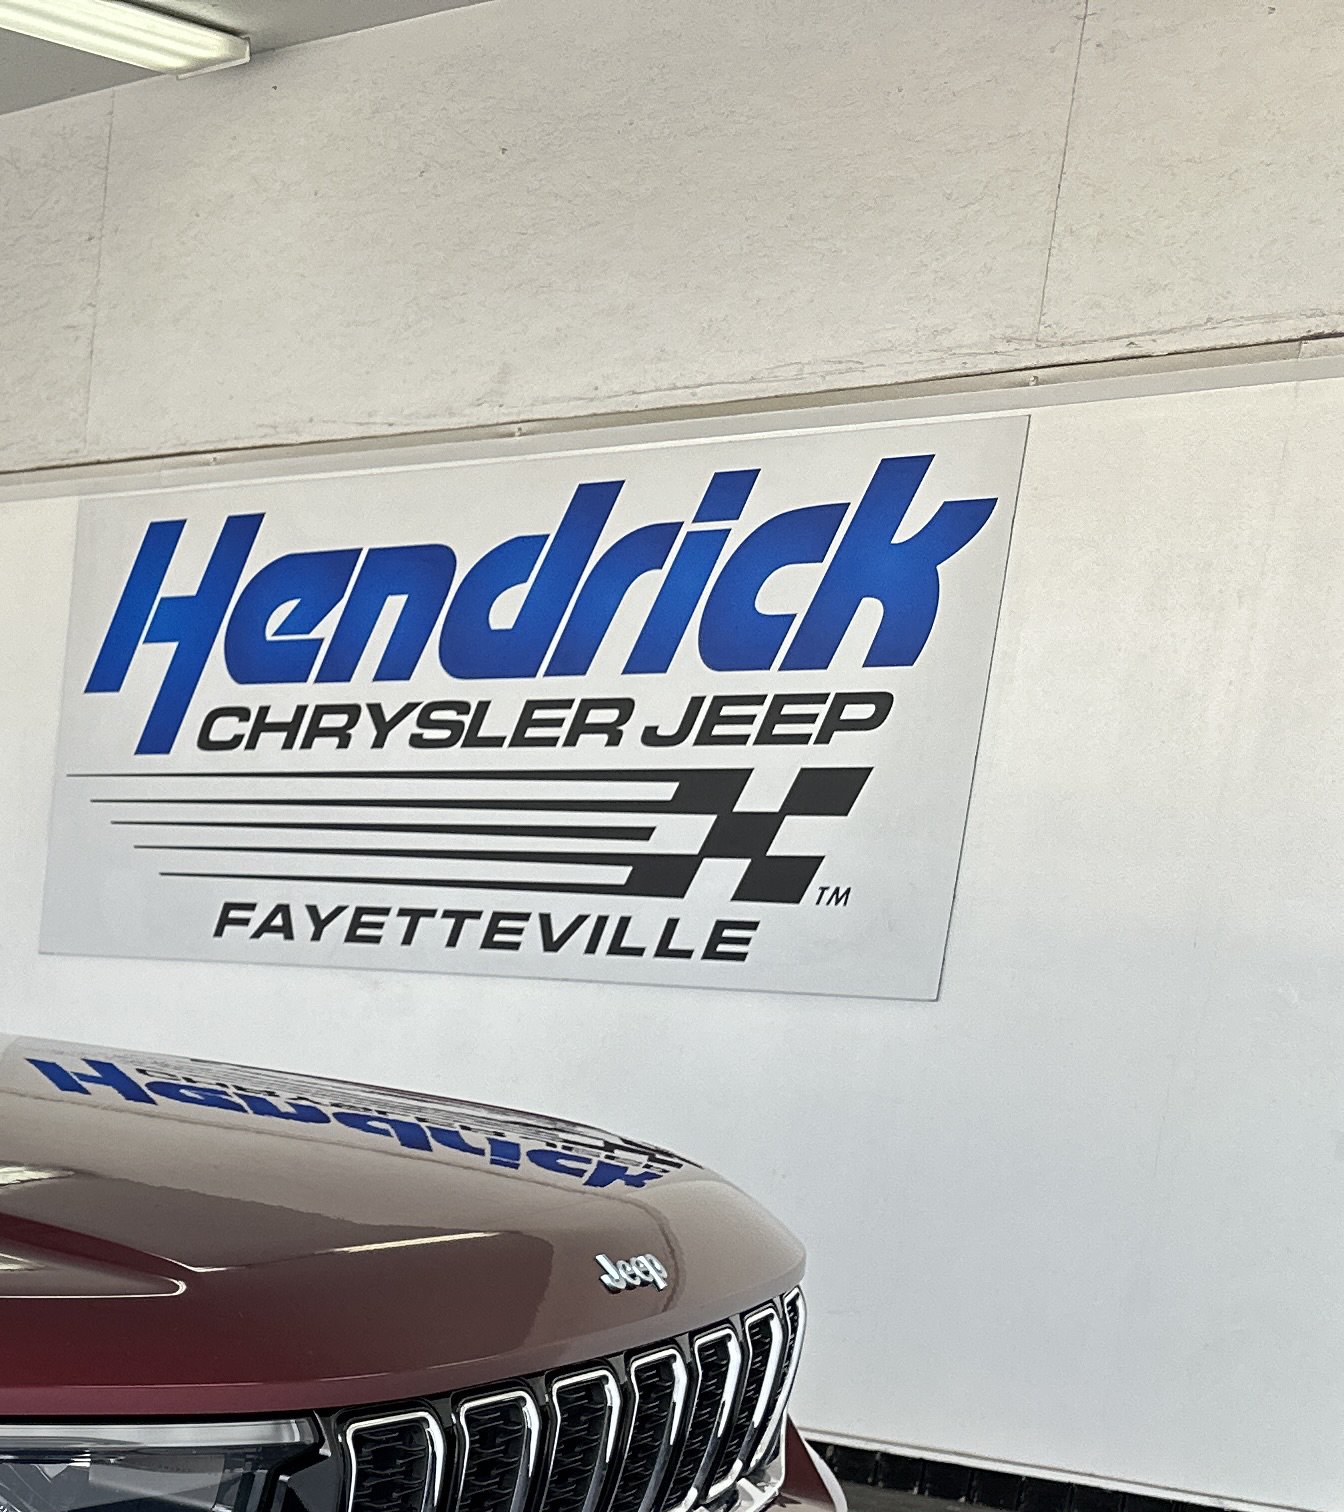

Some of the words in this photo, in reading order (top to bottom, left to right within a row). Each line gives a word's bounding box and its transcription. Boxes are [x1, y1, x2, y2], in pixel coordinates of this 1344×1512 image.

[83, 454, 998, 755] Hendrick
[196, 695, 637, 753] CHRYSLER
[640, 691, 894, 749] JEEP
[815, 886, 851, 906] TM
[212, 902, 761, 962] FAYETTEVILLE
[595, 1253, 668, 1290] Jeep
